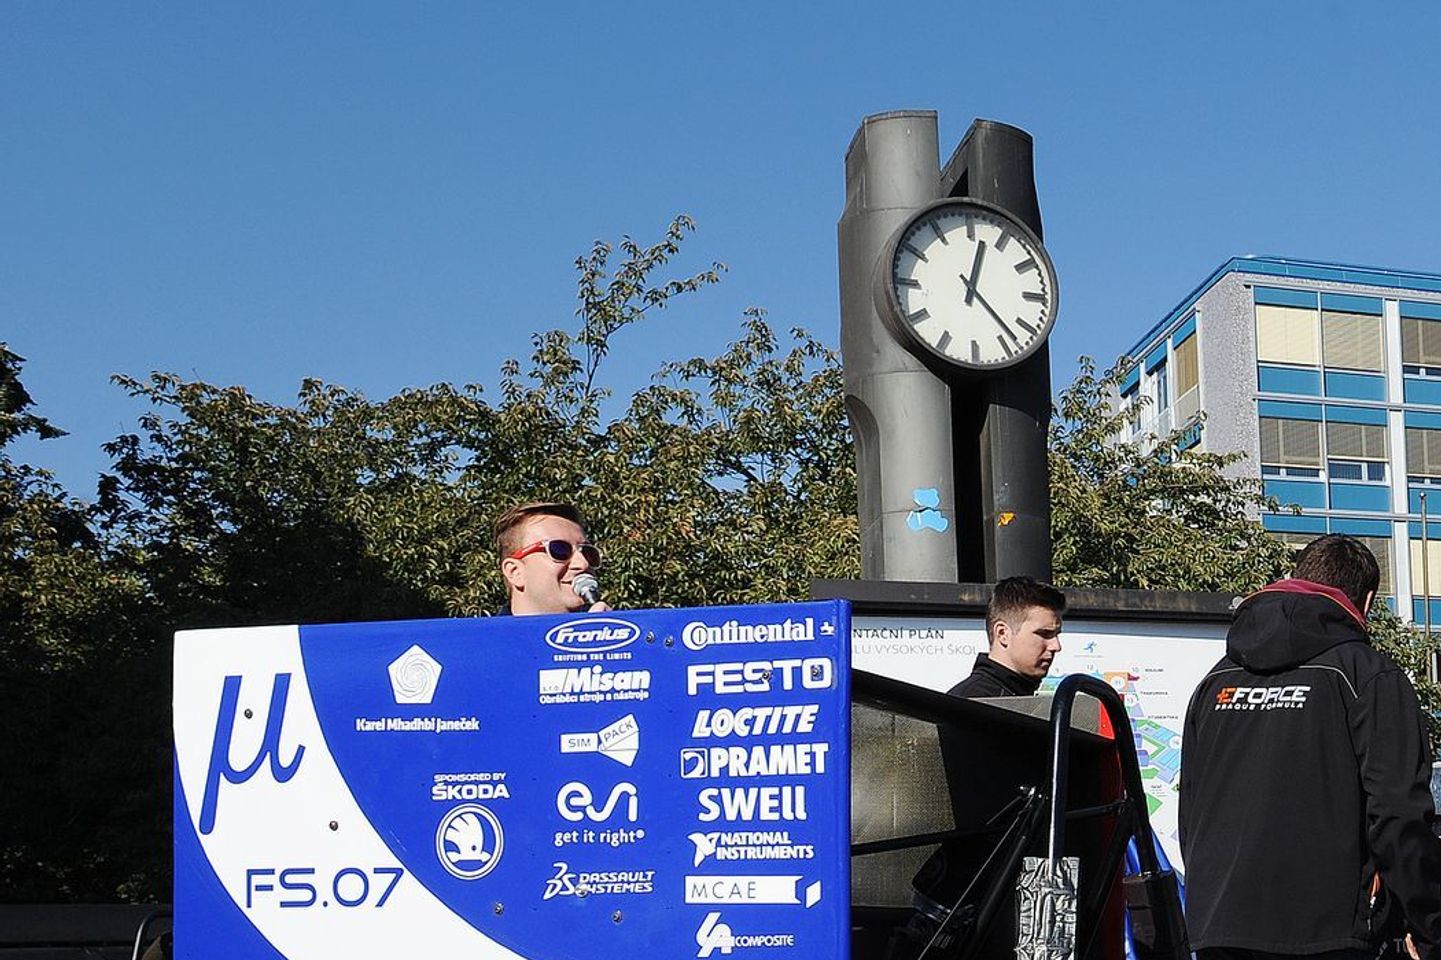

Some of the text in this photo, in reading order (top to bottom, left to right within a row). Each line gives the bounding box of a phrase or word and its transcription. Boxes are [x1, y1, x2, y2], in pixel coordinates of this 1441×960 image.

[556, 626, 632, 644] Fronius
[682, 617, 815, 651] Continental
[908, 627, 945, 640] PLÁN
[562, 664, 651, 693] Misan
[687, 657, 833, 696] FESTO
[1216, 686, 1312, 704] EFORCE
[356, 718, 385, 731] Karel
[692, 704, 819, 738] LOCTITE
[567, 720, 634, 748] SIM PACK
[710, 743, 829, 778] PRAMET
[492, 773, 506, 781] BY
[431, 783, 510, 801] ŠKODA
[557, 782, 638, 822] esi
[555, 830, 580, 847] get
[583, 829, 595, 844] it
[720, 832, 792, 845] NATIONAL
[716, 844, 815, 860] INSTRUMENTS
[579, 871, 655, 884] DASSAULT
[246, 867, 405, 909] FS.07
[690, 881, 757, 899] MCAE
[735, 934, 795, 948] COMPOSITE
